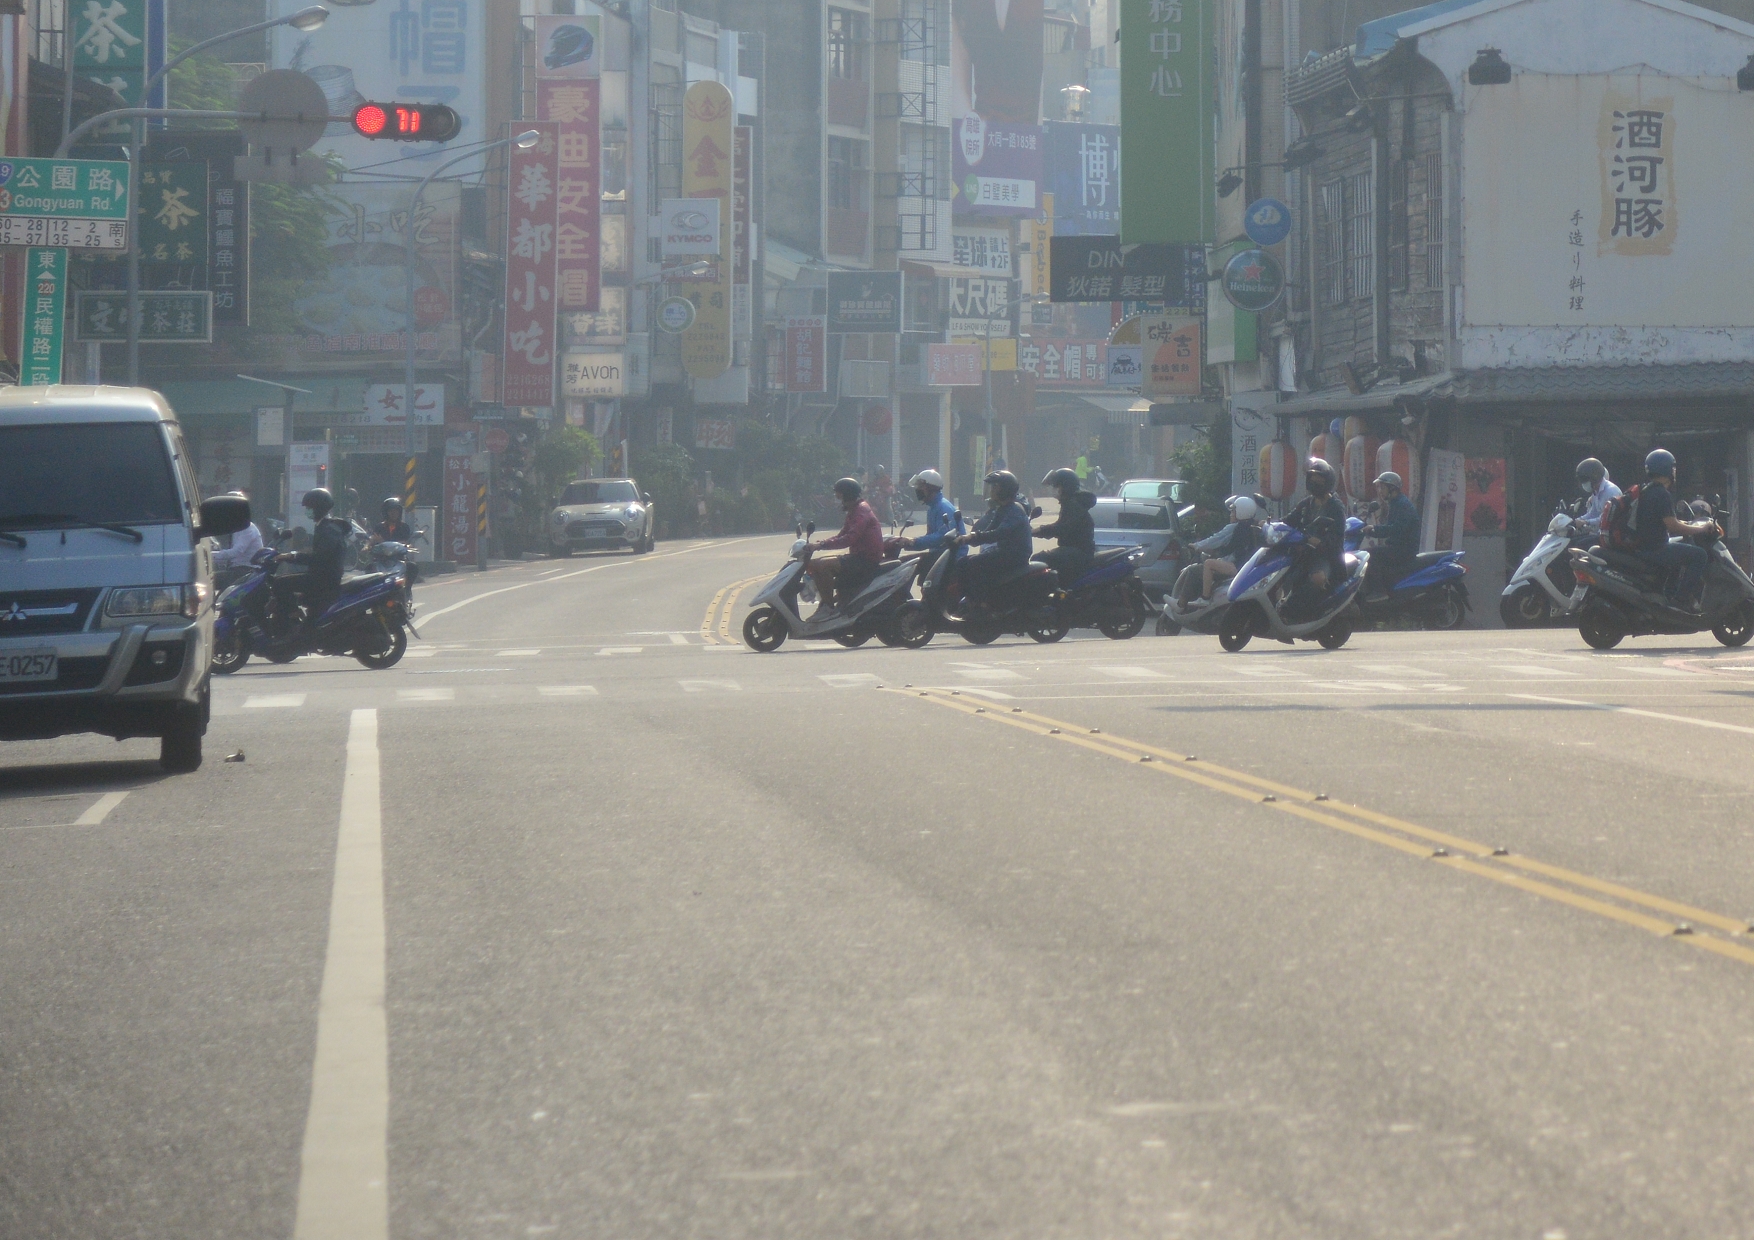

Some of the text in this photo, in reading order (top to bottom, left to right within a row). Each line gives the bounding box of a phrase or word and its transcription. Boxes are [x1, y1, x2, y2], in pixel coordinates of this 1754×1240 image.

[16, 165, 114, 191] 公園路
[1610, 109, 1665, 239] 酒河豚
[14, 194, 113, 211] Gongyuan Rd.
[154, 187, 200, 231] 茶
[109, 223, 124, 237] 南
[667, 234, 713, 244] KYMCO
[37, 251, 57, 268] 東
[509, 162, 553, 365] 華都小吃
[37, 283, 55, 294] 220
[1120, 275, 1166, 297] 髮型
[1230, 281, 1275, 292] Heineken
[30, 298, 54, 386] 民權路二段
[1022, 344, 1082, 380] 安全帽
[1240, 434, 1257, 486] 酒河豚
